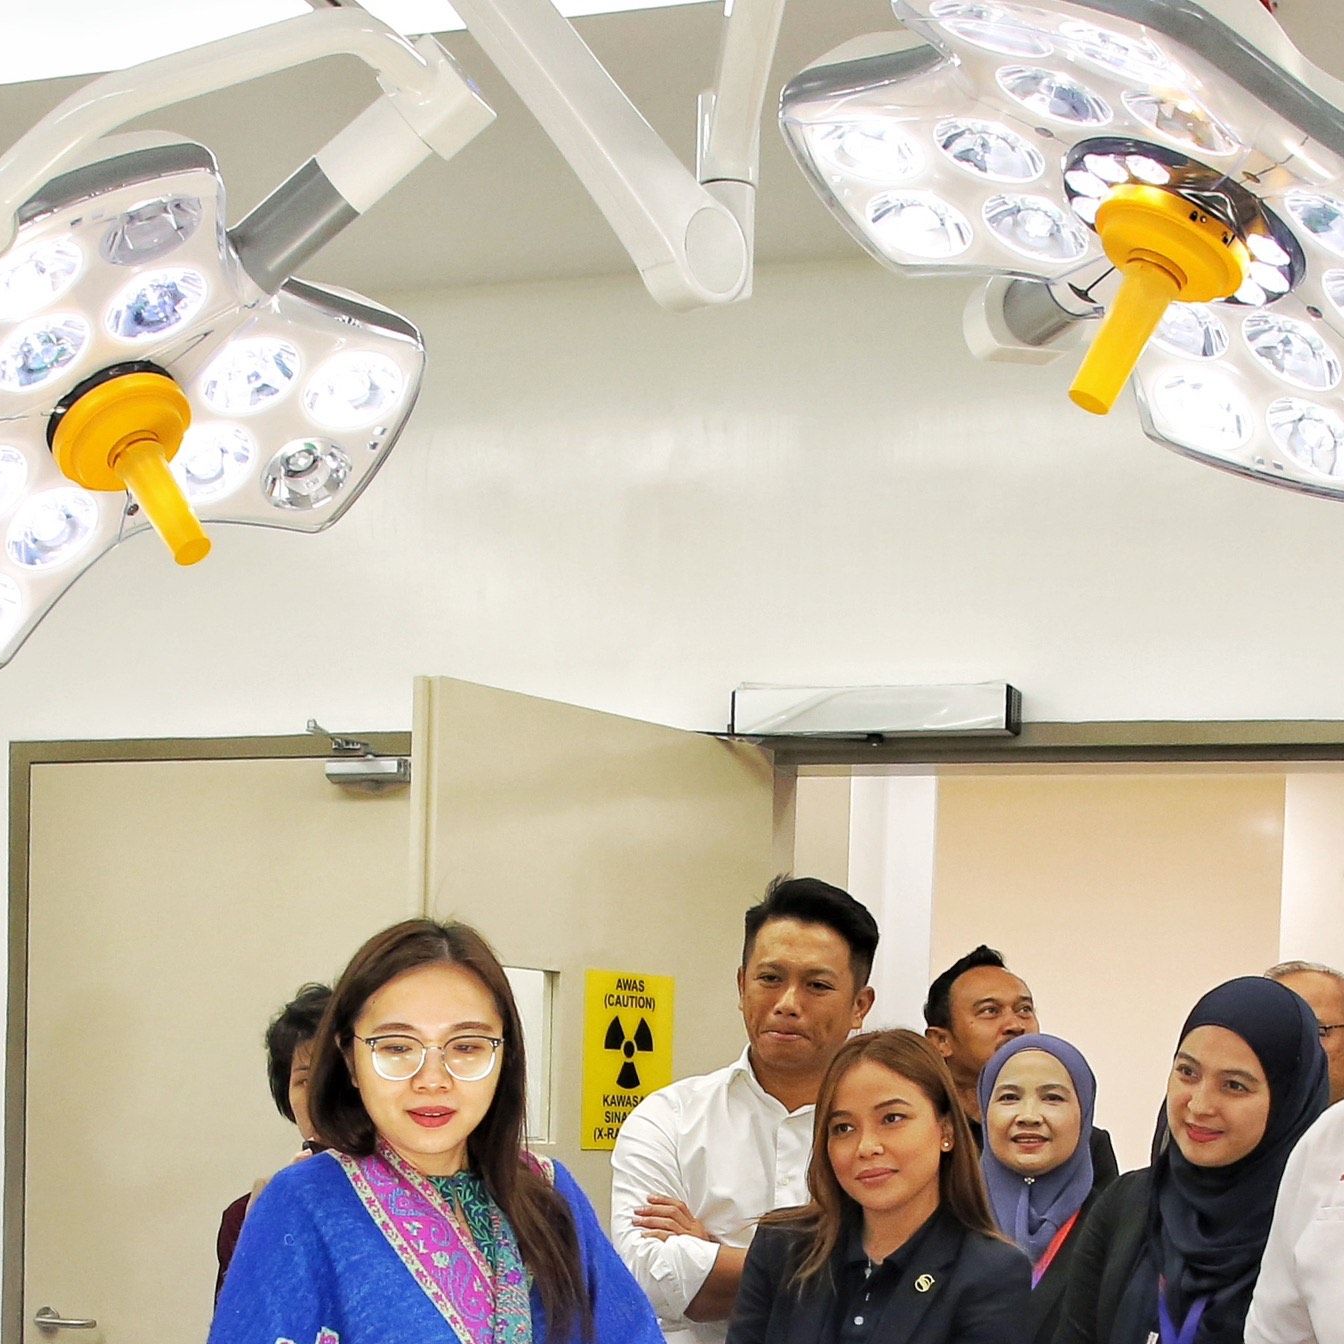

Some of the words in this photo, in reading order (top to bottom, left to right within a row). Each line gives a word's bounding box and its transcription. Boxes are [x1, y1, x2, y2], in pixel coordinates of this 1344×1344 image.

[615, 979, 645, 993] AWAS
[604, 993, 655, 1011] (CAUTION)
[602, 1094, 644, 1107] KAWAS
[604, 1111, 629, 1124] SINA
[593, 1127, 619, 1142] (X-RA
